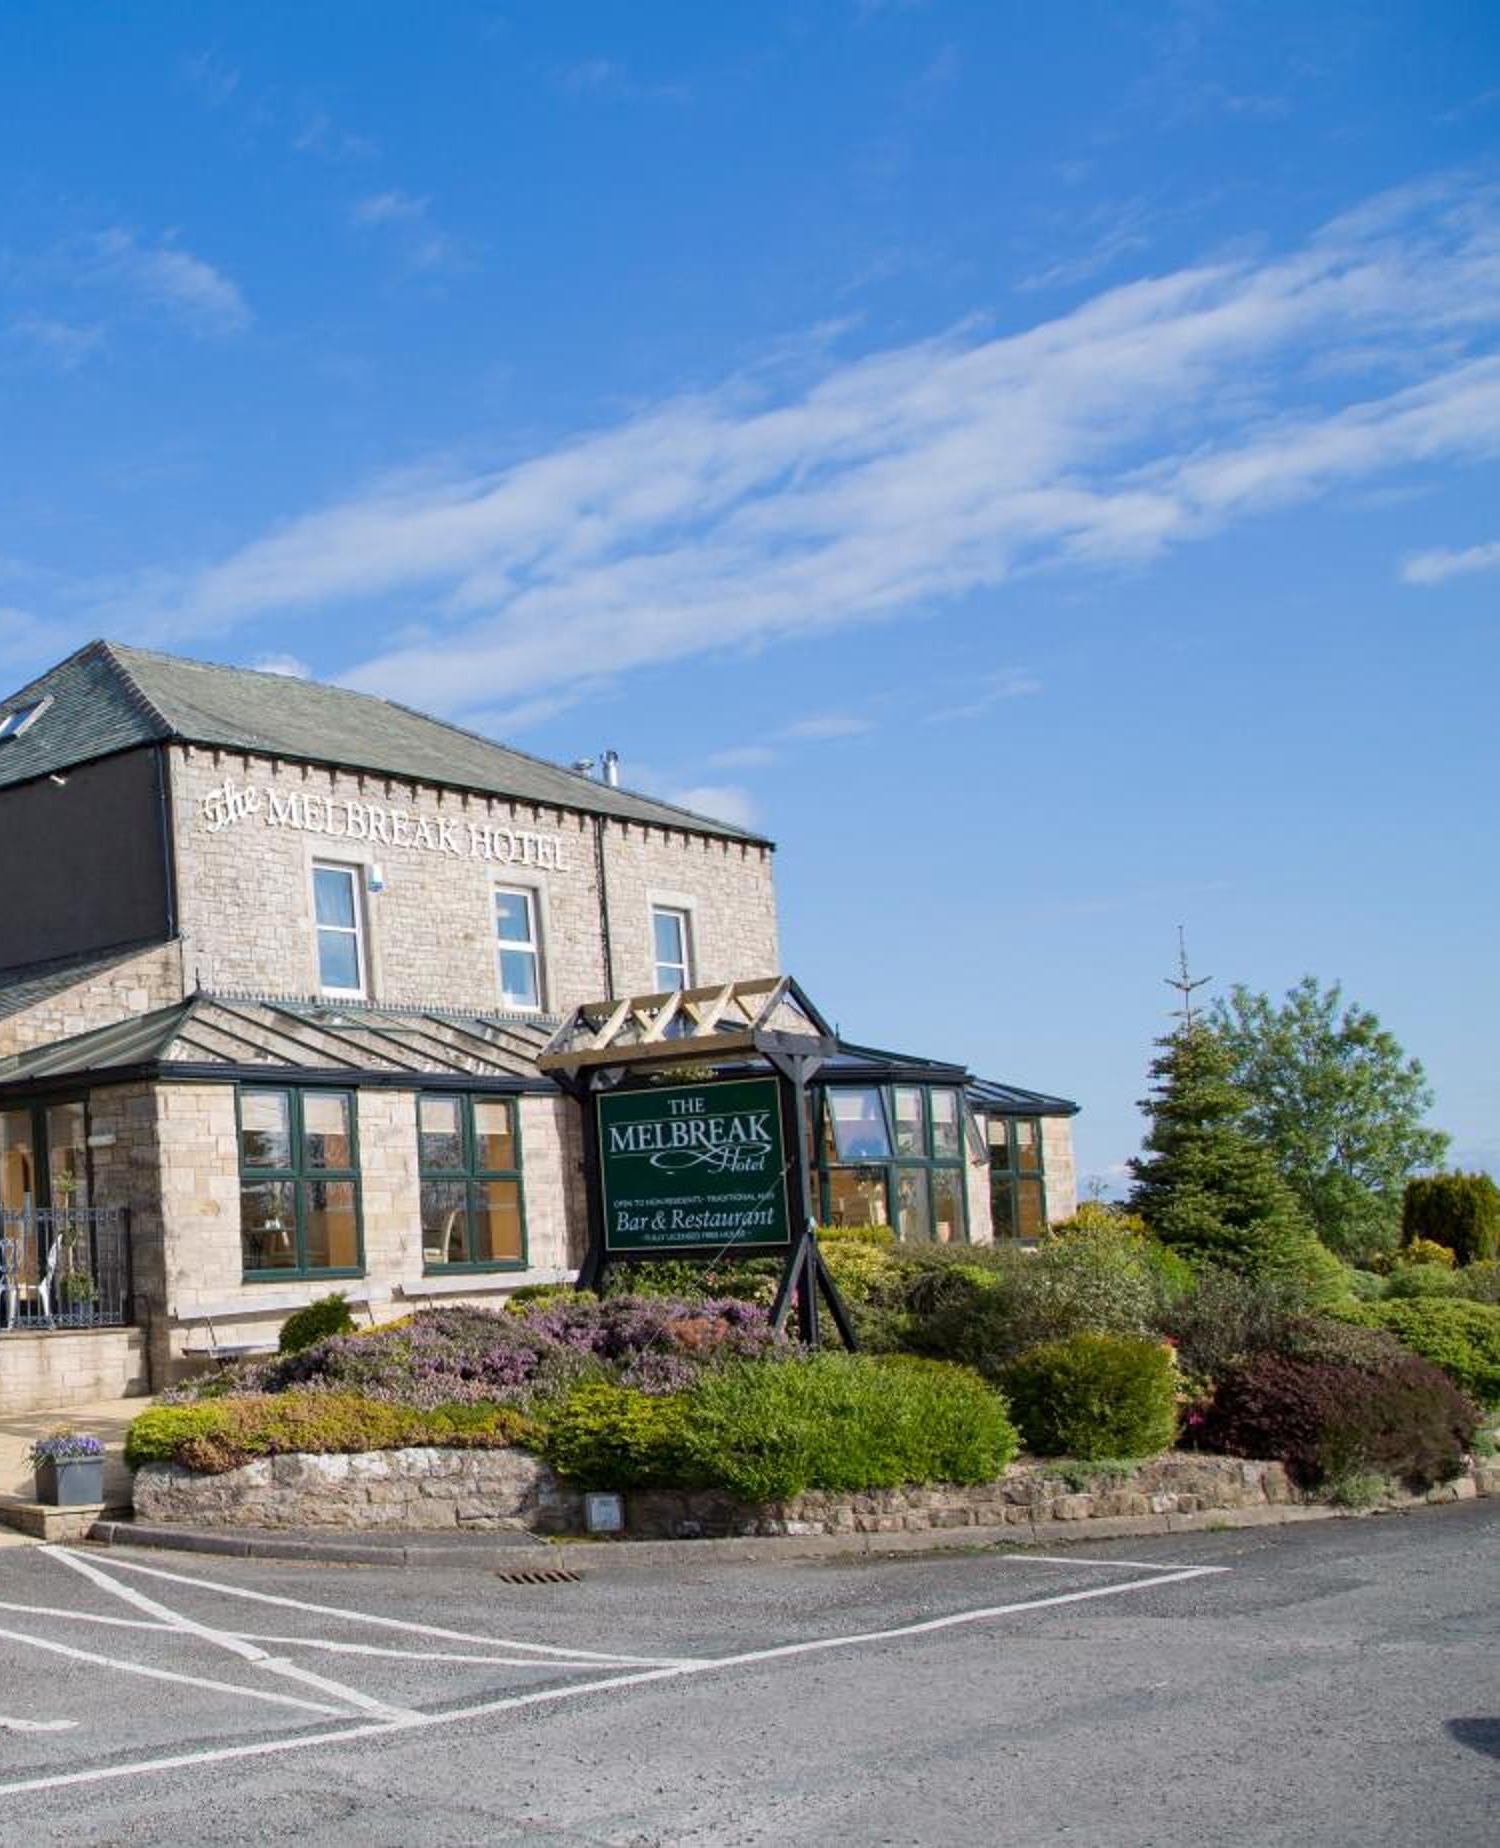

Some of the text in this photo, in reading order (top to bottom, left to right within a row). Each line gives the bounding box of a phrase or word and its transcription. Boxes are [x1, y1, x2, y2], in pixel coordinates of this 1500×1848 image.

[202, 777, 571, 872] The MELBREAK HOTEL
[667, 1098, 705, 1115] THE
[609, 1114, 773, 1152] MELBREAK
[708, 1145, 766, 1174] Hotel
[616, 1207, 775, 1232] Bar & Restaurant
